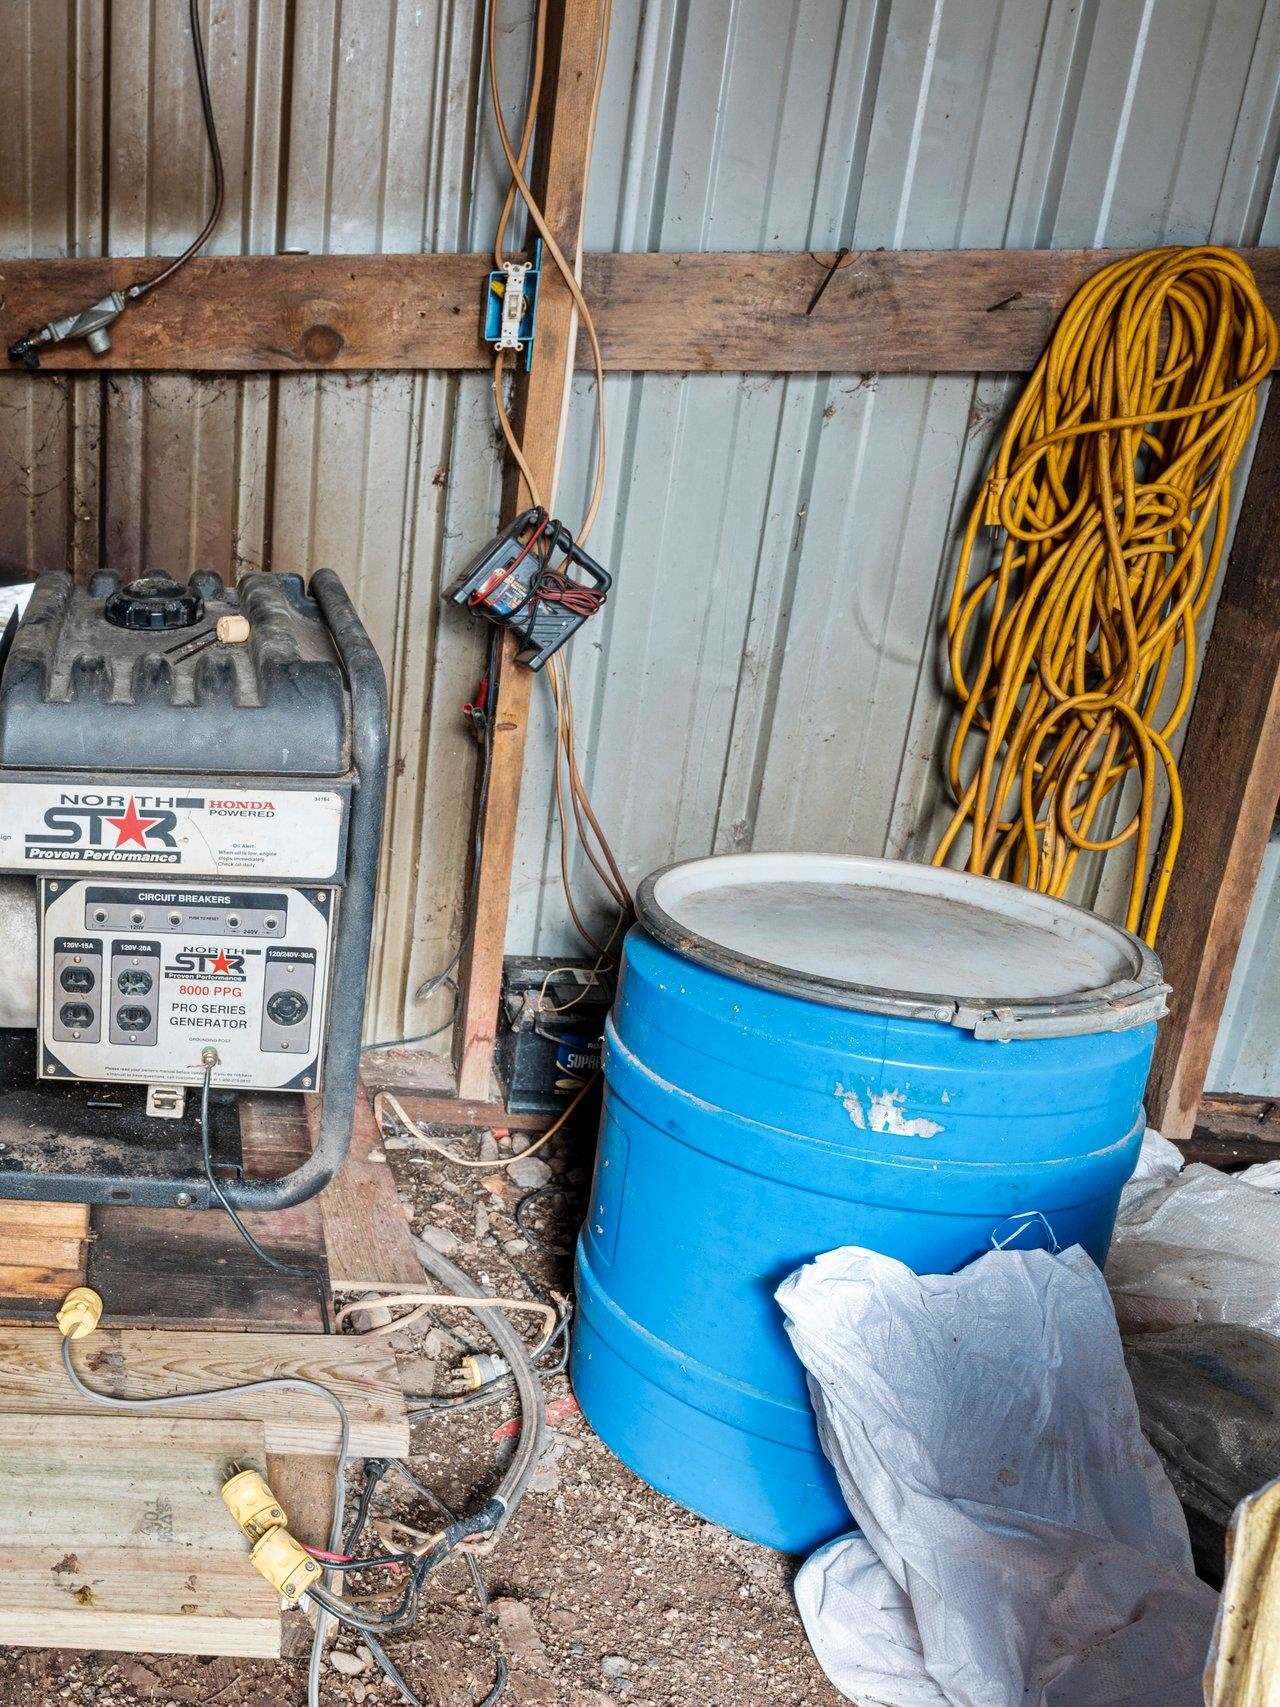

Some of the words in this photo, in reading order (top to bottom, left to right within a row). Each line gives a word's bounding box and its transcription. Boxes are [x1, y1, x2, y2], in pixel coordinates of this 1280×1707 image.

[60, 794, 174, 807] NORTH
[208, 799, 276, 810] HONDA
[208, 810, 276, 818] POWERED
[28, 848, 80, 860] Proven
[82, 849, 179, 863] Performance
[138, 892, 173, 903] CIRCUIT
[176, 893, 231, 905] BREAKERS
[183, 946, 245, 954] NORTH
[168, 973, 195, 981] Proven
[196, 974, 243, 982] Performance
[179, 985, 210, 996] 8000
[213, 986, 242, 998] PPG
[171, 1003, 198, 1013] PRO
[201, 1004, 246, 1015] SERIES
[169, 1017, 248, 1029] GENERATOR
